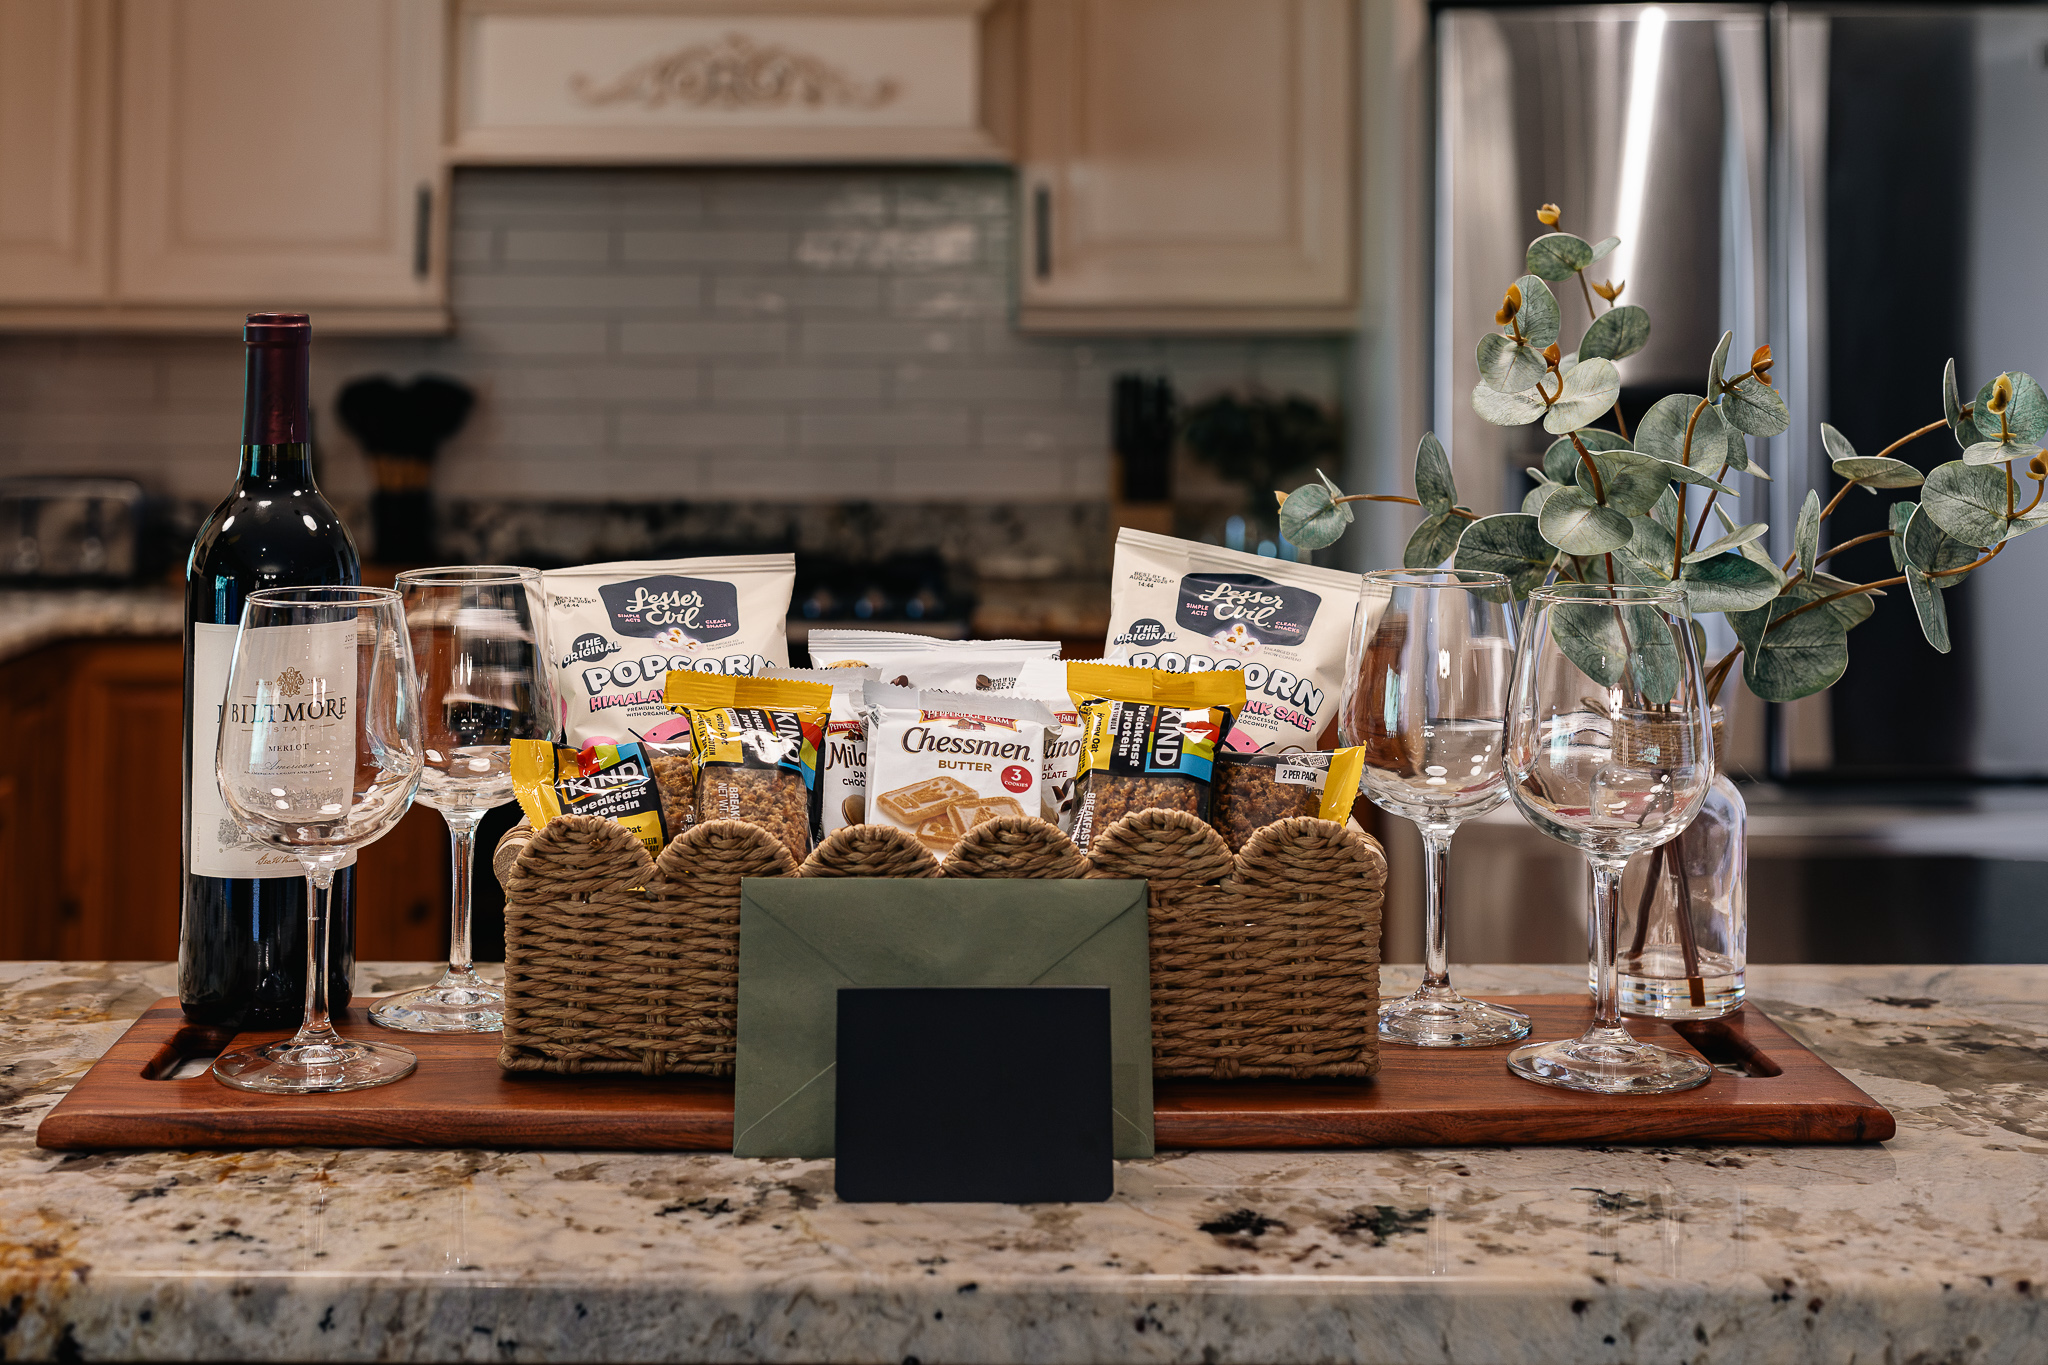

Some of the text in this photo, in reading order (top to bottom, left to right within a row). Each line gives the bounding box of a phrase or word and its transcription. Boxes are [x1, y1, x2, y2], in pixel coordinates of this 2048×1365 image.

[626, 586, 704, 612] Lesser
[1198, 582, 1284, 609] Lesser
[1186, 602, 1209, 611] SIMPLE
[1136, 625, 1160, 633] THE
[1274, 625, 1300, 634] SNACKS
[577, 637, 602, 650] THE
[1114, 632, 1177, 645] ORIGINAL
[562, 641, 622, 668] ORIGINAL
[230, 697, 347, 724] BILTMORE
[626, 705, 654, 713] PREMIUM
[927, 710, 1010, 725] PEPPERIDGE FARM
[1060, 713, 1075, 723] FARM
[1238, 718, 1269, 731] COCONUT
[1244, 714, 1279, 726] PROCESSED
[1275, 706, 1317, 732] SALT
[1118, 710, 1135, 757] protein
[1129, 704, 1150, 767] breakfast
[1155, 707, 1186, 766] KIND
[268, 743, 309, 752] MERLOT
[901, 726, 1032, 762] Chessmen
[1091, 738, 1101, 753] Oat
[938, 759, 993, 773] BUTTER
[568, 761, 640, 797] KIND
[1010, 768, 1022, 782] 3
[1282, 769, 1318, 783] 2 PER PACK
[718, 782, 728, 798] NET
[1003, 780, 1029, 788] COOKIES
[572, 785, 648, 815] breakfast
[588, 799, 640, 818] rotein
[1081, 792, 1096, 846] BREAKFAST
